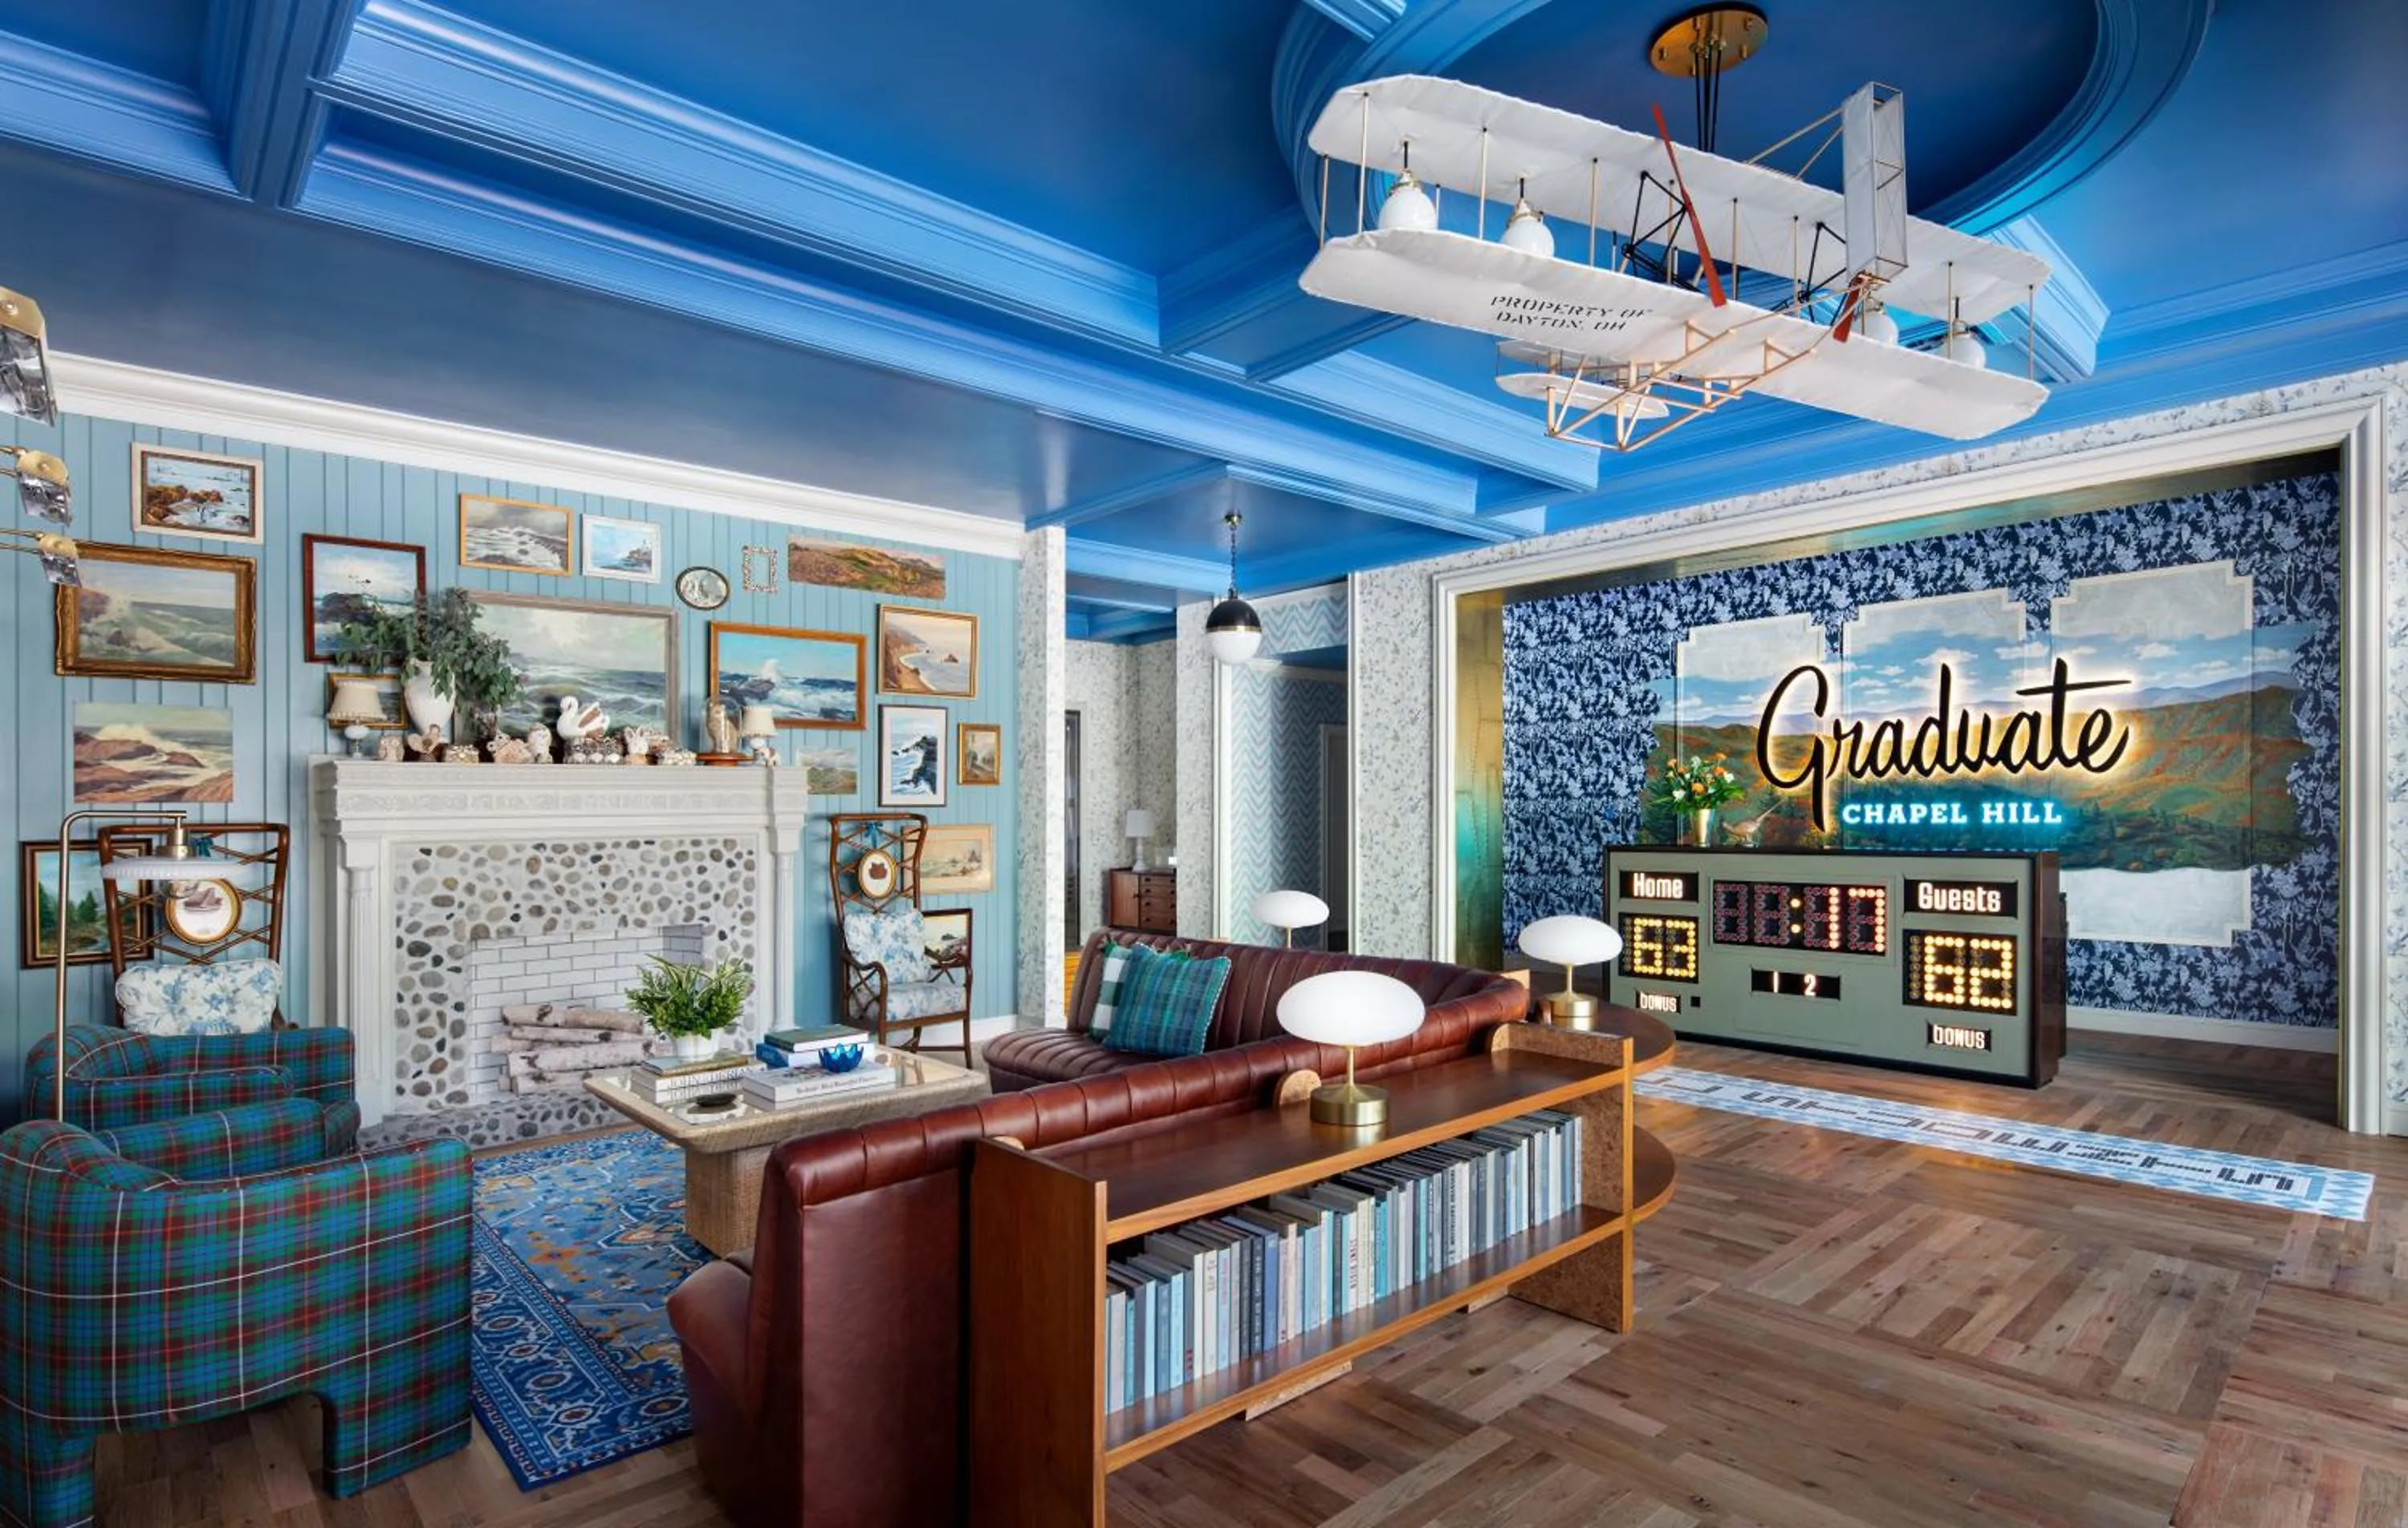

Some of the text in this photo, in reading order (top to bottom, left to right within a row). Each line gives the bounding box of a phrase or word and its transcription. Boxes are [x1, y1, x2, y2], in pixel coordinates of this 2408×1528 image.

[1491, 296, 1653, 318] PROPERTY OF
[1593, 321, 1626, 331] OH
[1757, 656, 2133, 832] Graduate
[1842, 803, 2063, 824] CHAPEL HILL
[1633, 872, 1684, 899] Home
[1918, 882, 2002, 912] Guests
[1633, 917, 1696, 978] 63
[1804, 973, 1817, 997] 2
[1924, 935, 2012, 1010] 62
